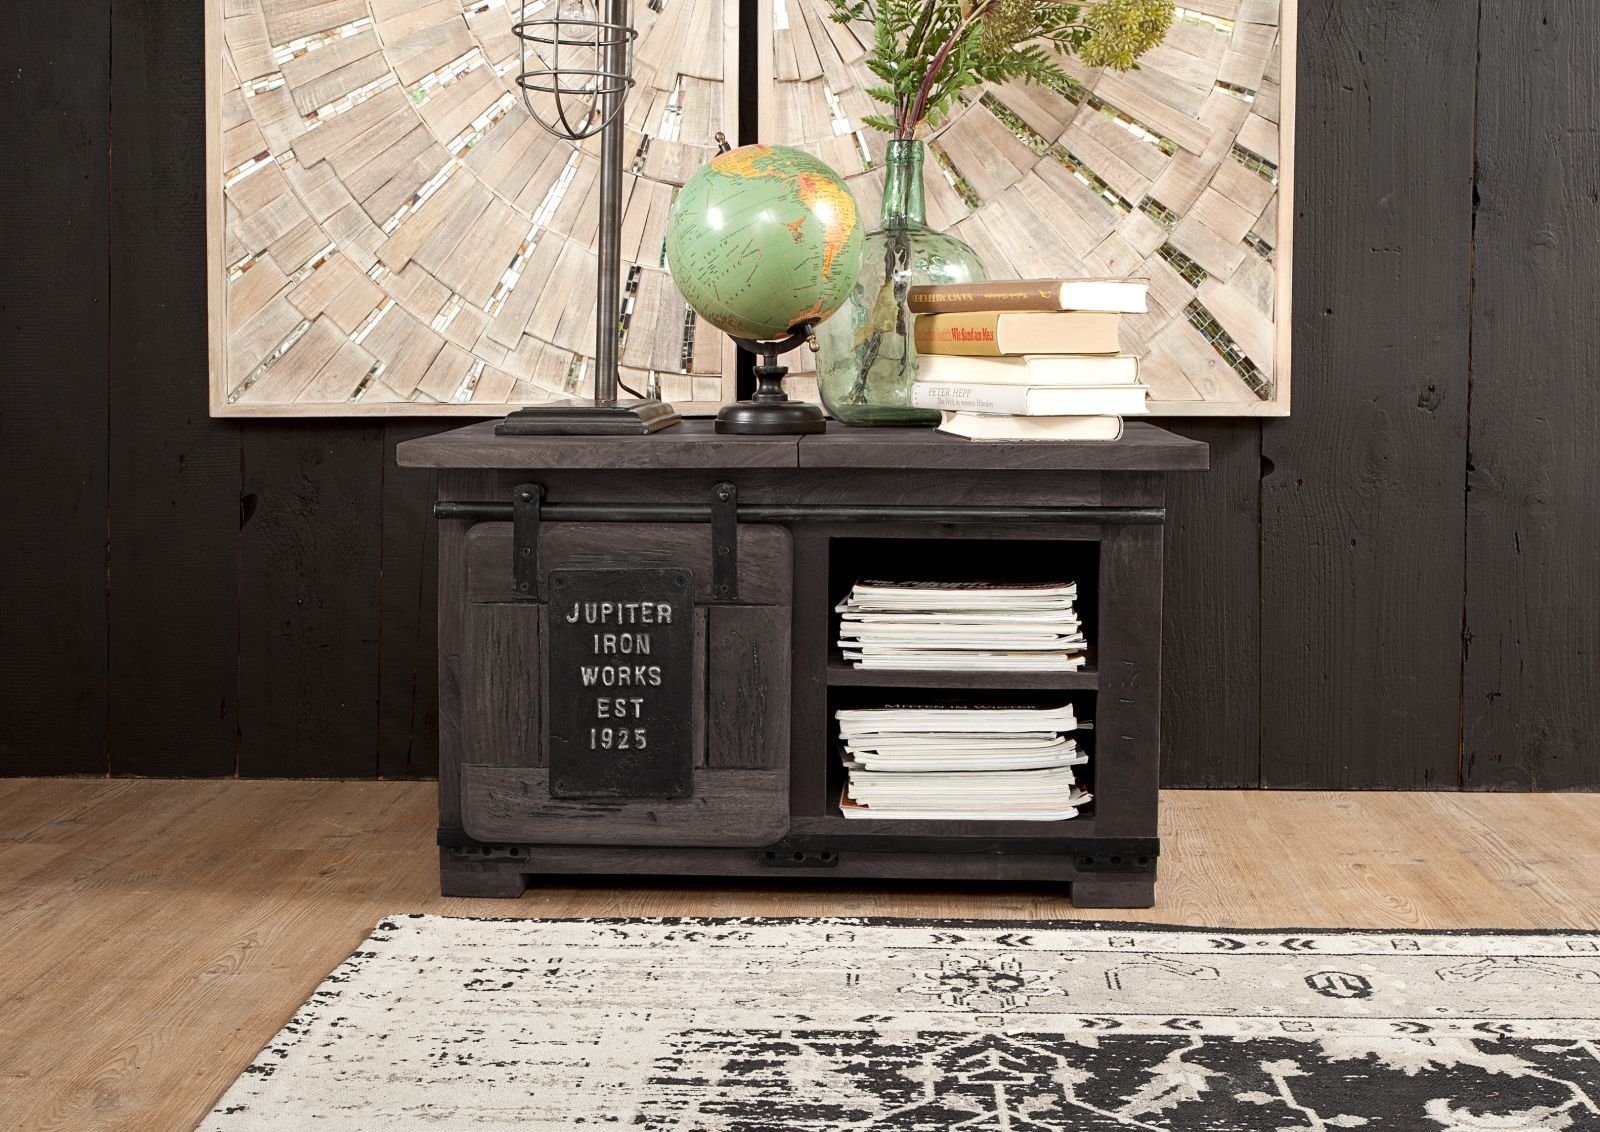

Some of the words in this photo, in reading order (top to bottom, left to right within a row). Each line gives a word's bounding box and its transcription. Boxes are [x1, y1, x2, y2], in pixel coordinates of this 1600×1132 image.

[928, 387, 951, 397] PETER
[952, 388, 972, 398] HEPP
[566, 602, 673, 625] JUPITER
[593, 633, 651, 655] IRON
[580, 666, 662, 687] WORKS
[597, 698, 644, 719] EST
[590, 728, 647, 750] 1925
